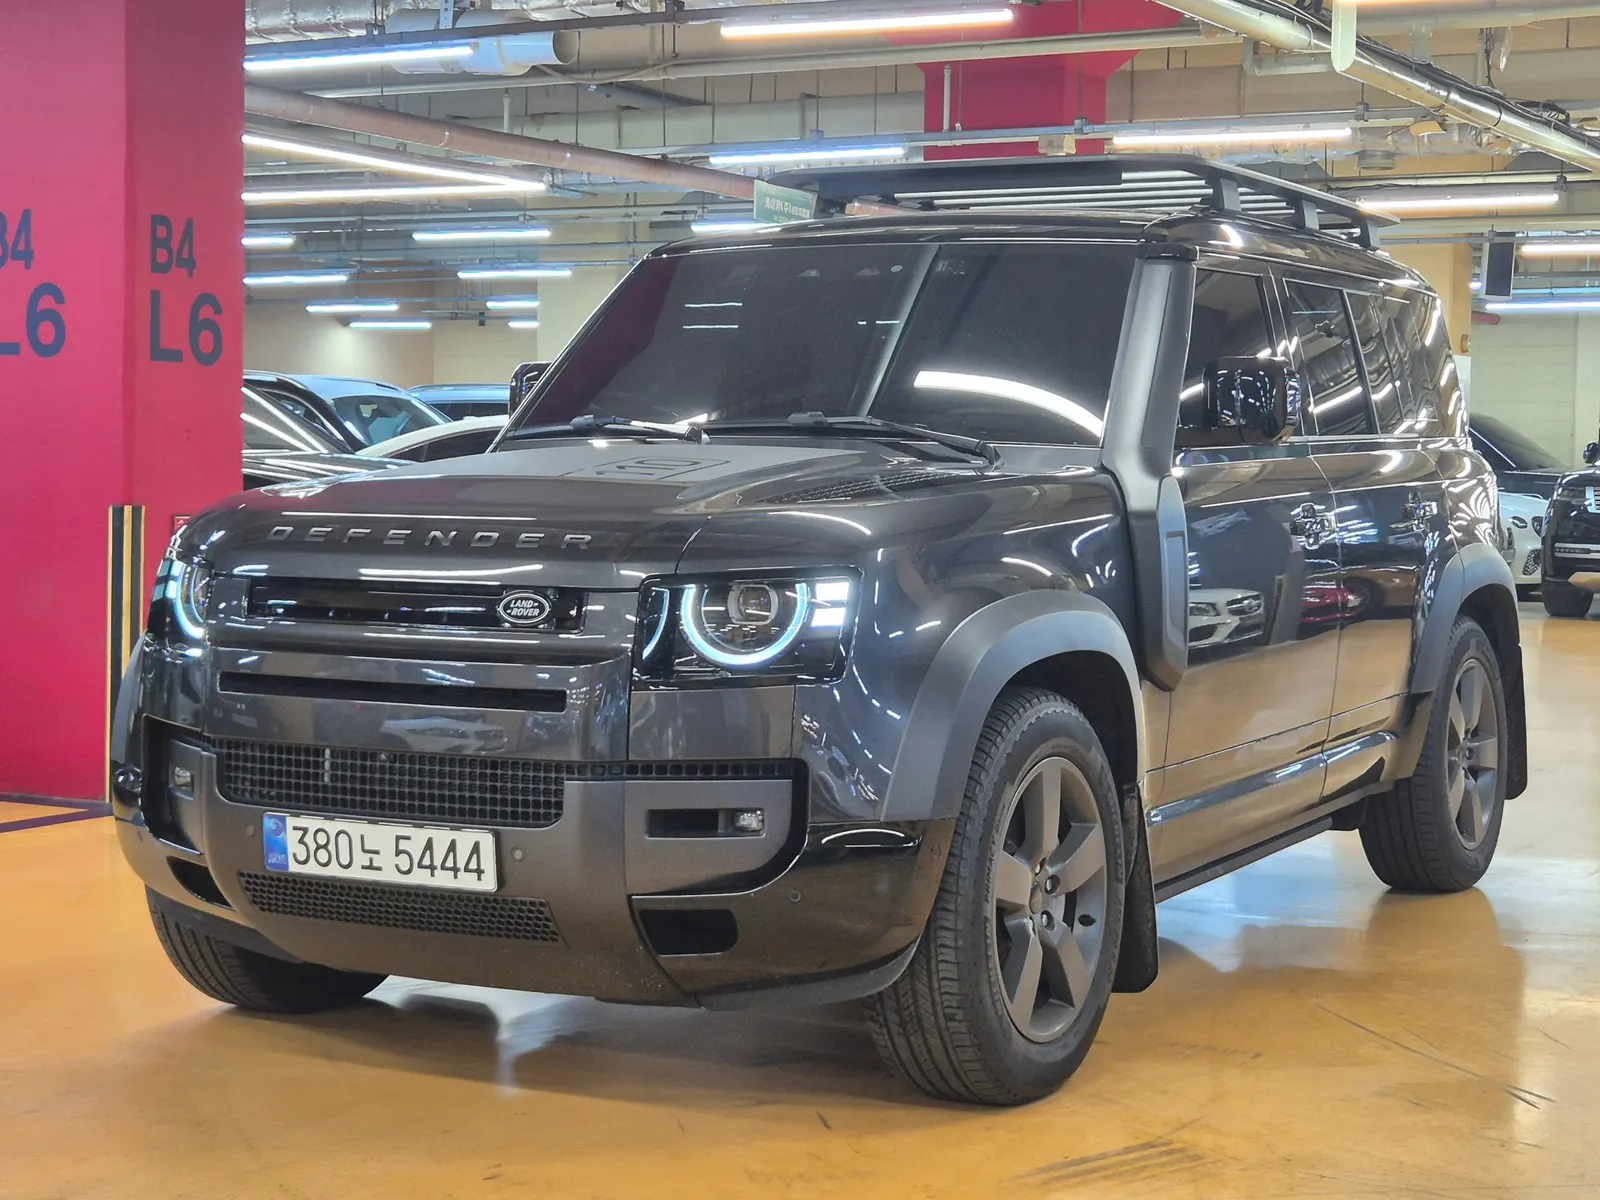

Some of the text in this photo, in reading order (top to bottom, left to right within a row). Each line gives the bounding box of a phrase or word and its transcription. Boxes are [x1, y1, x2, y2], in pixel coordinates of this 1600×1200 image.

[150, 214, 196, 277] B4
[150, 289, 223, 366] L6
[267, 525, 593, 550] DEFENDER
[511, 607, 540, 616] ROVER
[292, 825, 485, 881] 380노 5444
